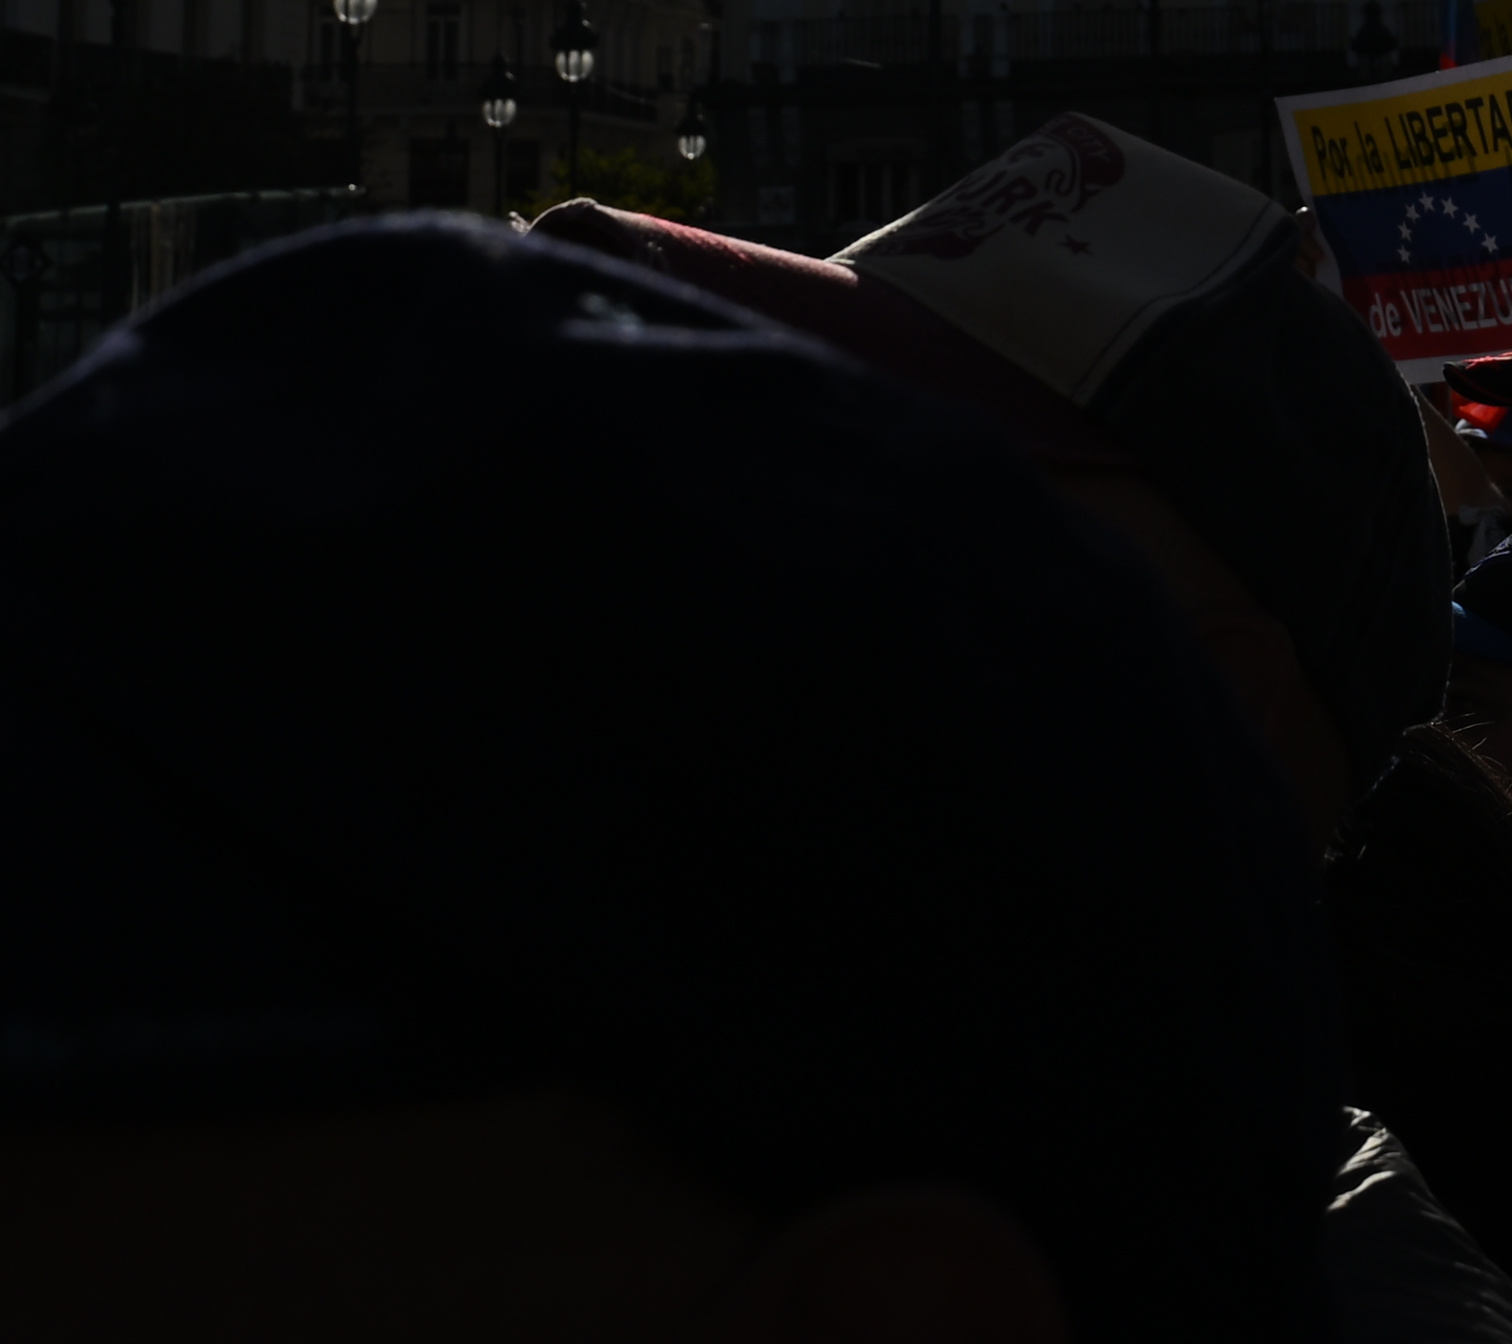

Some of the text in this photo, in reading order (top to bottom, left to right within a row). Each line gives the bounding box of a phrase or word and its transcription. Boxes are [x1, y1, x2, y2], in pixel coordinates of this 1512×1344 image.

[1311, 125, 1353, 180] Por
[1354, 121, 1385, 174] la
[1368, 292, 1403, 339] de
